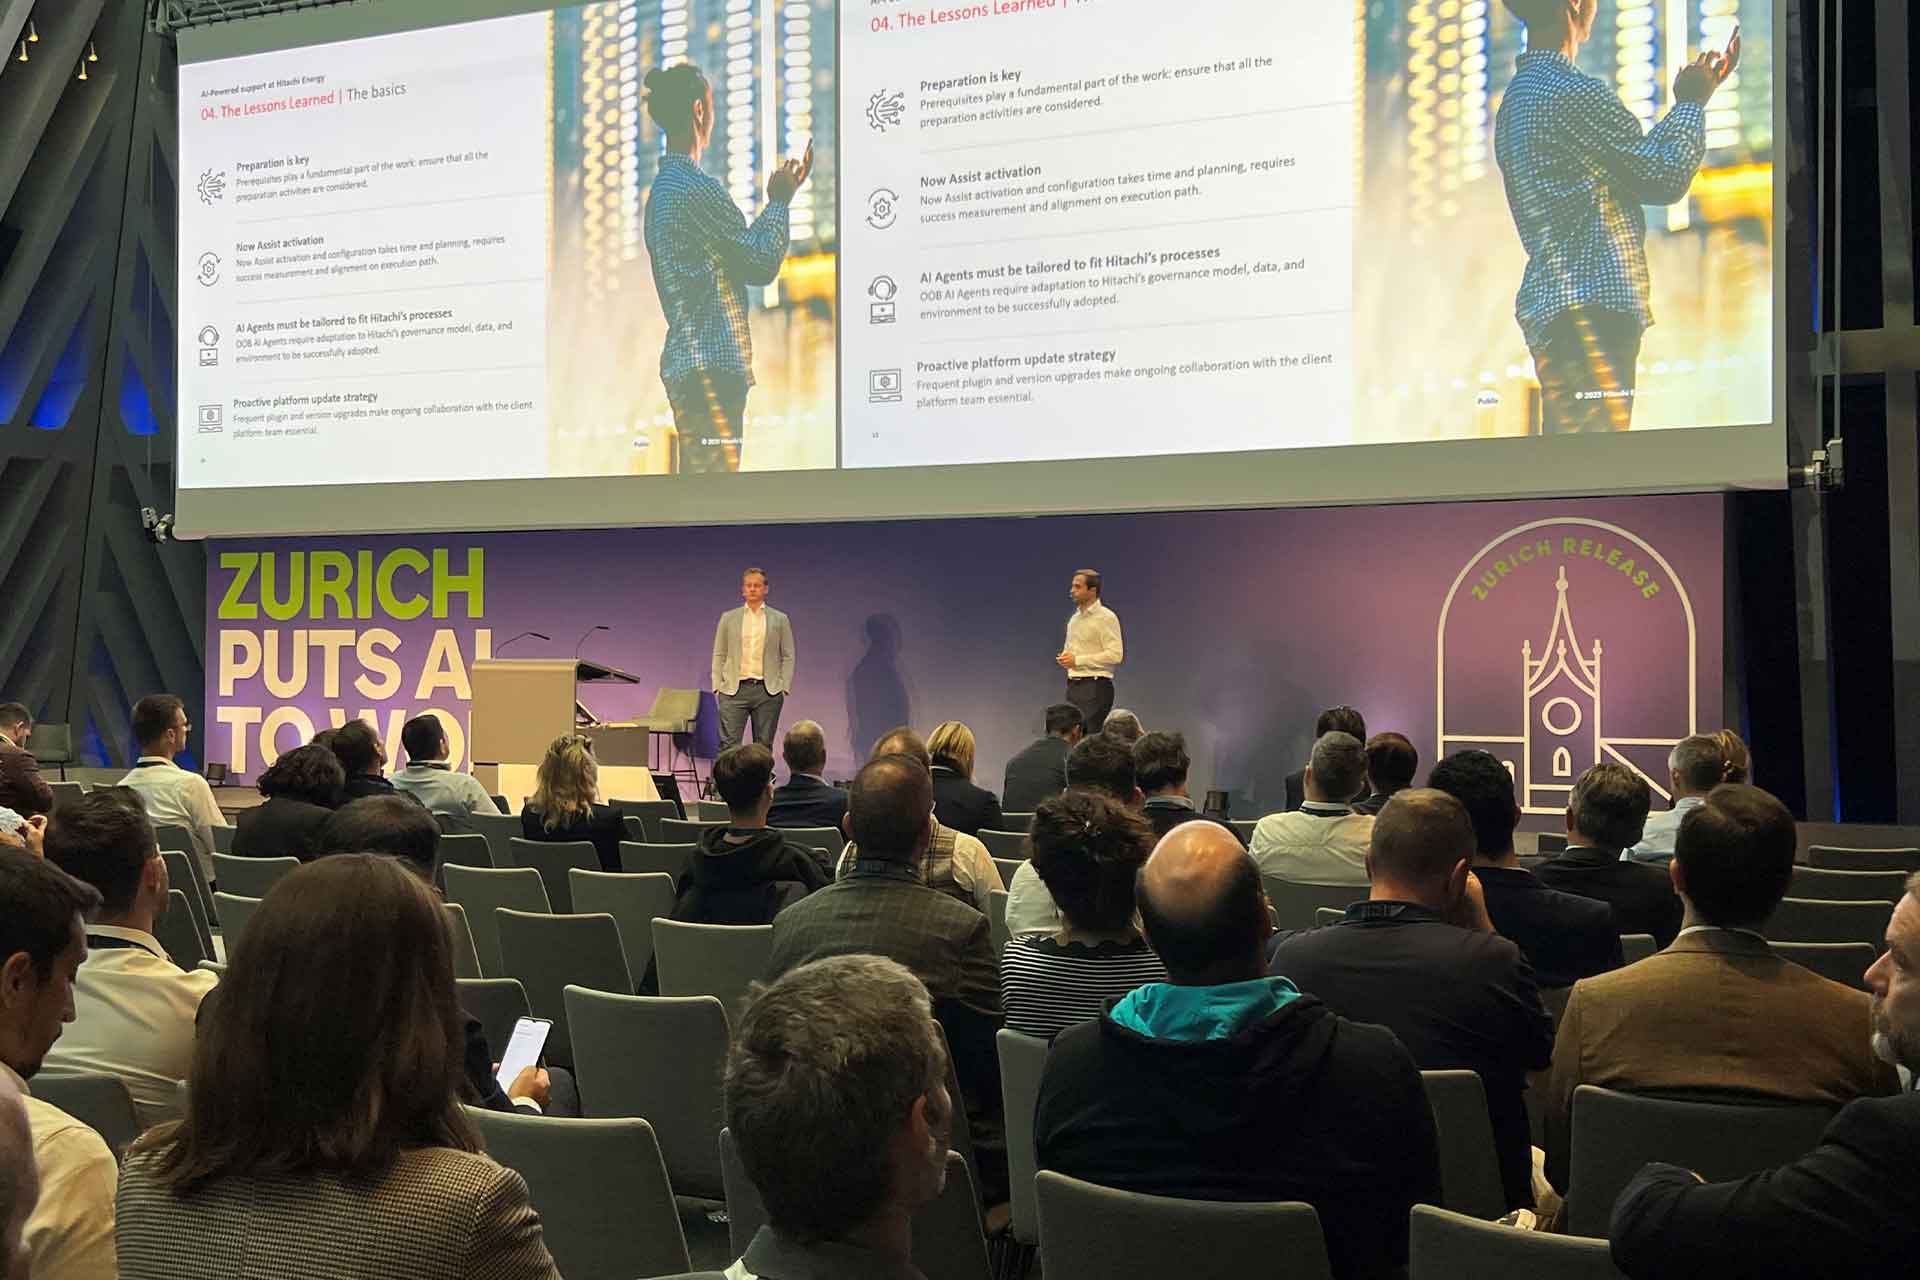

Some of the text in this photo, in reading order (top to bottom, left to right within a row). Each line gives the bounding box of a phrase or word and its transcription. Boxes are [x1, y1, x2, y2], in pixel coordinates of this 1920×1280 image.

[898, 10, 925, 29] The
[929, 1, 988, 24] Lessons
[919, 93, 983, 113] Prerequisites
[985, 90, 1006, 105] play
[1008, 91, 1014, 99] a
[1016, 80, 1082, 98] fundamental
[1083, 77, 1106, 92] part
[1107, 75, 1118, 87] of
[1121, 73, 1139, 85] the
[1173, 66, 1211, 78] ensure
[1213, 61, 1235, 73] that
[1238, 59, 1251, 70] all
[1254, 56, 1272, 68] the
[920, 69, 1021, 94] Preparation is key
[218, 102, 241, 119] The
[243, 96, 287, 115] Lessons
[288, 89, 337, 110] Learned
[346, 86, 369, 103] The
[371, 80, 407, 99] basics
[919, 111, 977, 131] preparation
[978, 106, 1023, 121] activities
[1025, 106, 1043, 115] are
[235, 157, 285, 175] Preparation
[294, 154, 309, 168] key
[919, 165, 1041, 187] Now Assist activation
[919, 194, 942, 206] Now
[944, 191, 972, 204] Assist
[973, 185, 1023, 200] activation
[1025, 183, 1045, 195] and
[1047, 176, 1115, 195] configuration
[1117, 172, 1145, 185] takes
[1146, 170, 1172, 182] time
[1173, 167, 1196, 179] and
[1249, 156, 1295, 174] requires
[919, 213, 956, 224] success
[957, 203, 1026, 220] measurement
[1028, 201, 1048, 213] and
[1050, 196, 1101, 213] alignment
[1103, 196, 1118, 205] on
[1120, 188, 1172, 203] execution
[235, 235, 324, 252] Now Assist activation
[919, 249, 1220, 286] AI Agents must be tailored to fit Hitachi's processes
[919, 291, 942, 303] OOB
[944, 290, 955, 300] AI
[956, 287, 990, 302] Agents
[992, 283, 1028, 299] require
[1030, 278, 1086, 296] adaptation
[1087, 277, 1100, 288] to
[1101, 273, 1145, 287] Hitachi's
[1147, 270, 1210, 285] governance
[1283, 259, 1305, 271] and
[246, 320, 275, 335] Agents
[276, 319, 297, 330] must
[311, 315, 345, 328] tailored
[358, 314, 368, 324] fit
[369, 311, 407, 323] Hitachi's
[408, 310, 452, 323] processes
[920, 305, 982, 320] environment
[982, 304, 995, 315] to
[996, 303, 1010, 314] be
[1011, 298, 1071, 315] successfully
[915, 354, 1332, 394] Frequent plugin and version upgrades make ongoing collaboration with the client
[916, 349, 1116, 372] Proactive platform update strategy
[232, 391, 378, 409] Proactive platform update strategy
[915, 396, 958, 411] platform
[959, 394, 985, 406] team
[217, 547, 485, 621] ZURICH
[1471, 536, 1660, 601] ZURICH RELEASE
[219, 628, 402, 699] PUTS
[216, 706, 316, 774] TO
